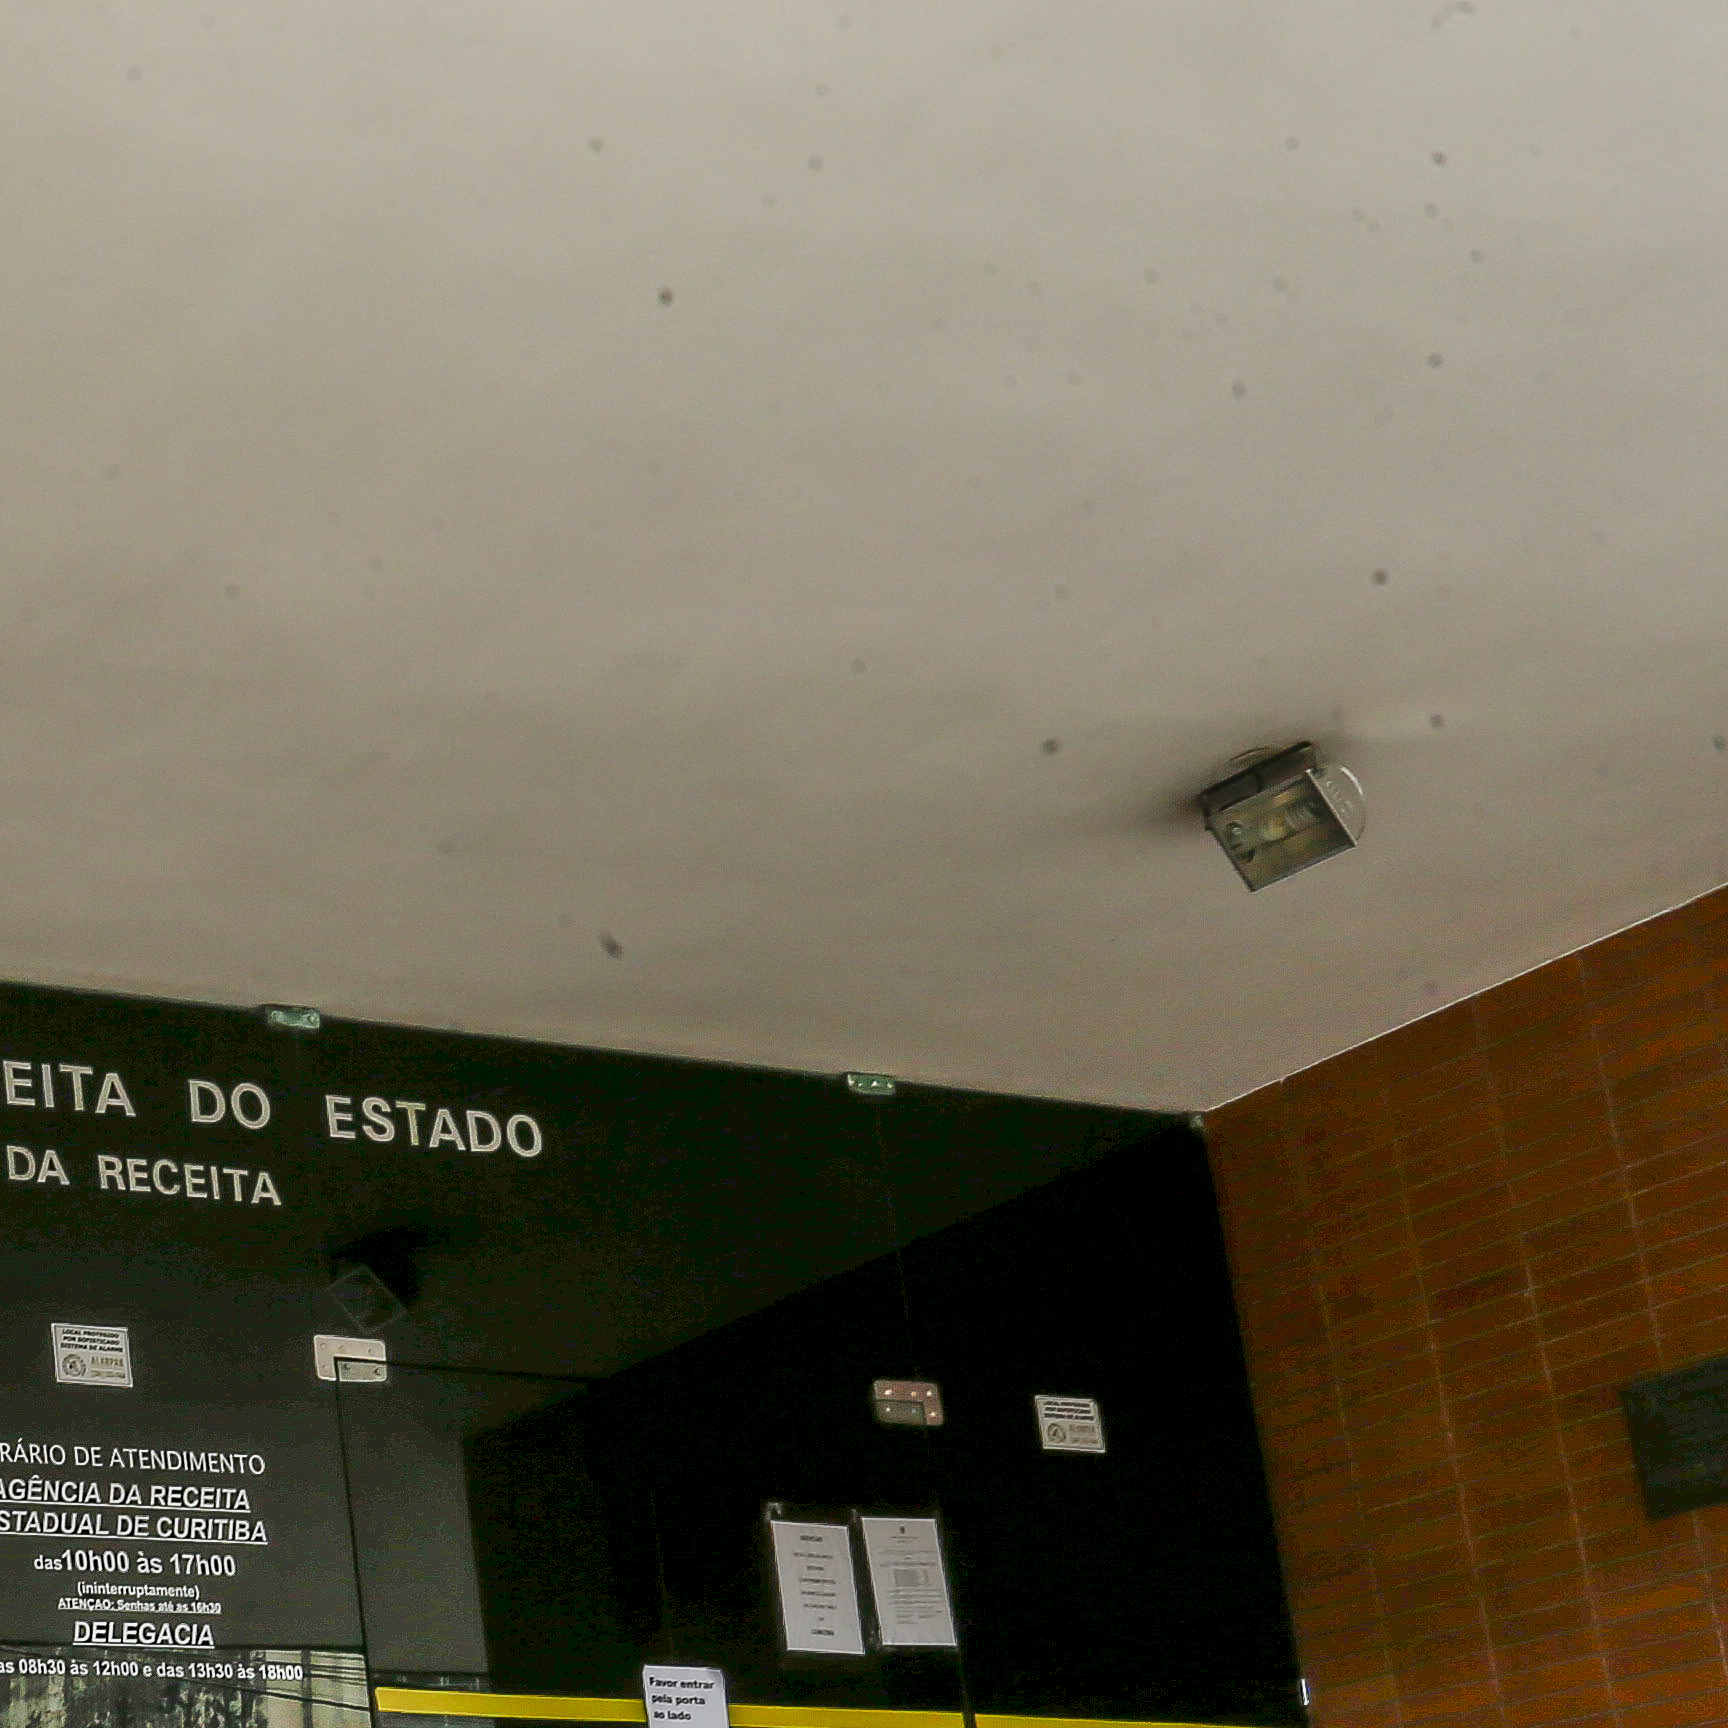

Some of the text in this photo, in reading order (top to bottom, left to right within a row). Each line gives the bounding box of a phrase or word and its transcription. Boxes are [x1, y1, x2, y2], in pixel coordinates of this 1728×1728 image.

[189, 1079, 272, 1130] DO
[325, 1095, 542, 1158] ESTADO
[7, 1146, 69, 1186] DA
[99, 1157, 282, 1206] RECEITA
[74, 1446, 103, 1466] DE
[109, 1447, 266, 1475] ATENDIMENTO
[109, 1483, 142, 1504] DA
[150, 1485, 250, 1510] RECEITA
[117, 1515, 150, 1536] DE
[156, 1516, 267, 1542] CURITIBA
[136, 1551, 163, 1573] às
[169, 1553, 236, 1576] 17h00
[77, 1581, 200, 1599] (ininterruptamente)
[116, 1601, 155, 1611] Senhas
[73, 1621, 214, 1646] DELEGACIA
[19, 1659, 65, 1674] 08h30
[70, 1660, 88, 1675] às
[92, 1661, 139, 1676] 12h00
[143, 1666, 153, 1677] e
[156, 1662, 185, 1677] das
[188, 1663, 233, 1678] 13h30
[237, 1664, 255, 1679] às
[259, 1665, 303, 1680] 18h00
[649, 1677, 714, 1689] Favor entrar
[652, 1694, 706, 1706] pela porta
[653, 1711, 692, 1720] ao lado
